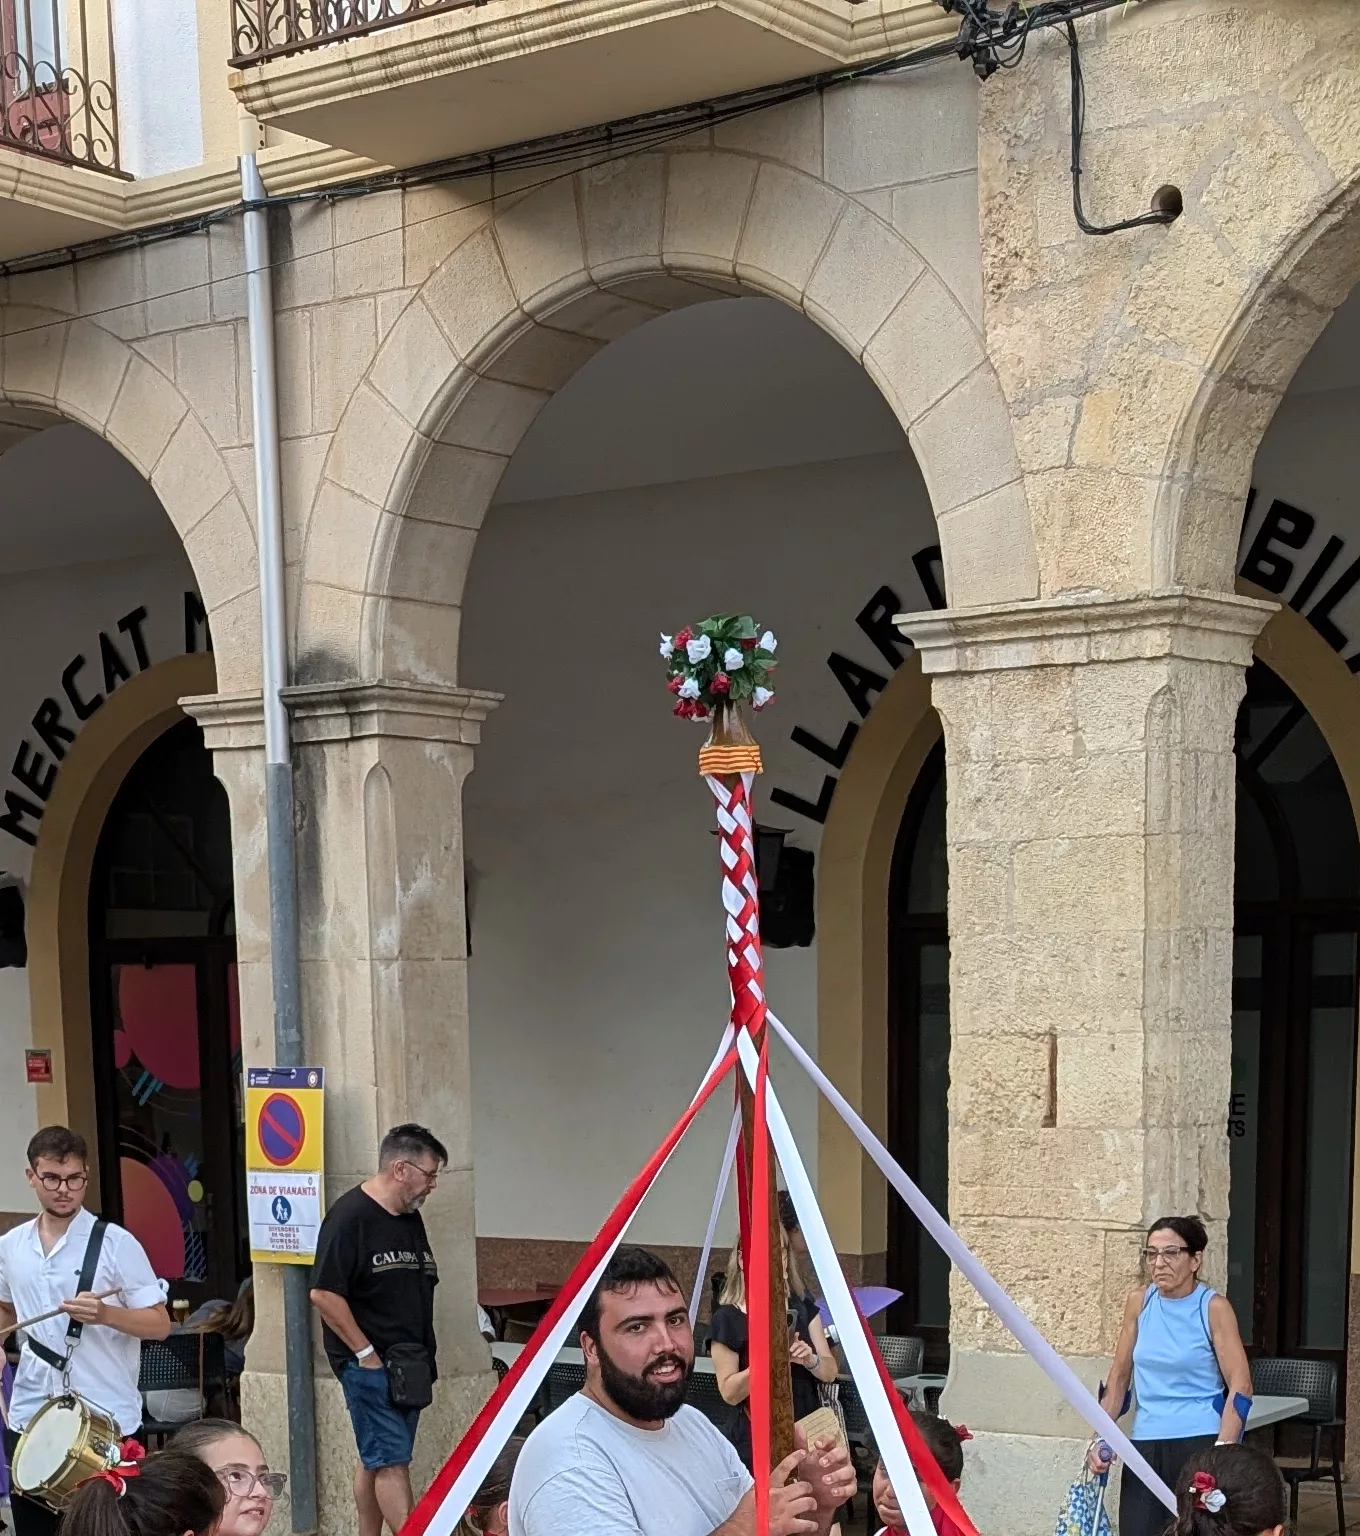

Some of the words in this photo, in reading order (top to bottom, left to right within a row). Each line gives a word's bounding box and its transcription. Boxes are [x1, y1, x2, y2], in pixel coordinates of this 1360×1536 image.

[250, 1186, 267, 1194] ZONA
[269, 1186, 277, 1195] DE
[279, 1187, 317, 1196] VIANANTS
